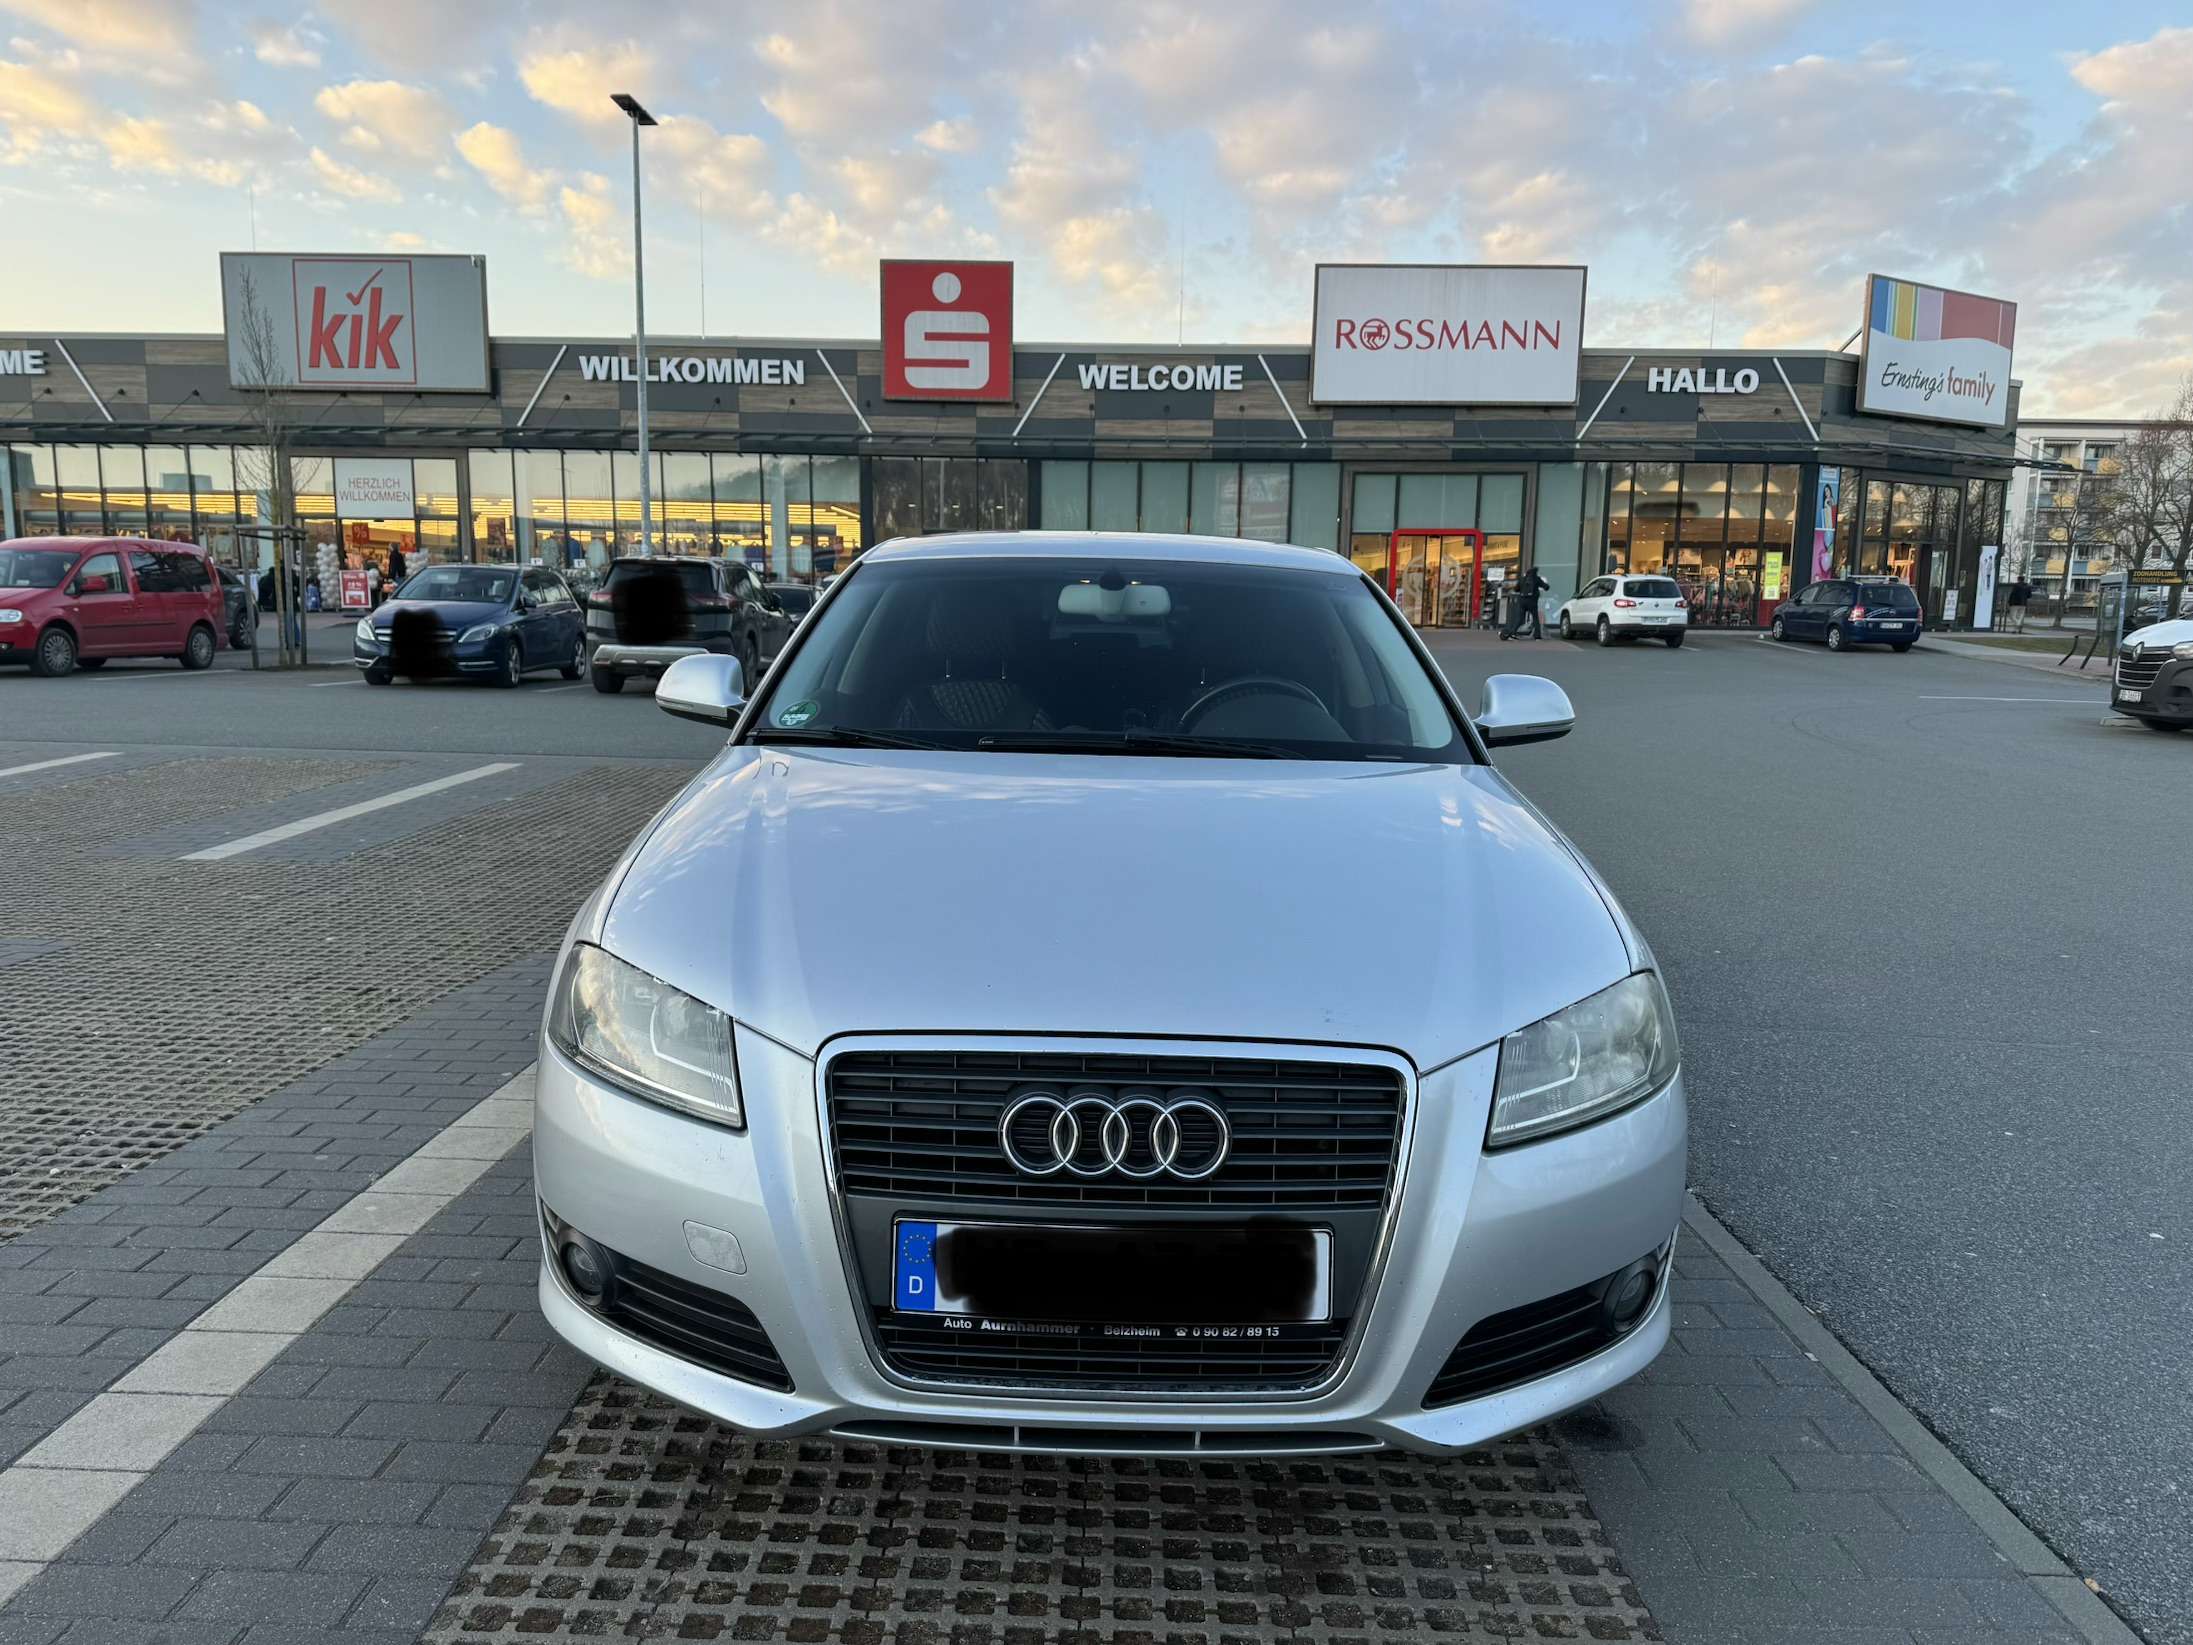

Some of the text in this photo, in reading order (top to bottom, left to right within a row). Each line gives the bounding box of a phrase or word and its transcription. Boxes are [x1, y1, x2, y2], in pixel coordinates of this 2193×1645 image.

[1335, 318, 1561, 351] ROSSMANN
[578, 355, 806, 385] WILLKOMMEN
[1078, 364, 1244, 391] WELCOME
[1647, 367, 1760, 394] HALLO
[1946, 365, 1996, 406] family
[339, 490, 410, 502] WILLKOMMEN
[348, 477, 400, 489] HERZLICH
[909, 1275, 924, 1294] D
[943, 1317, 973, 1330] Auto
[980, 1319, 1081, 1335] Aurnhammer
